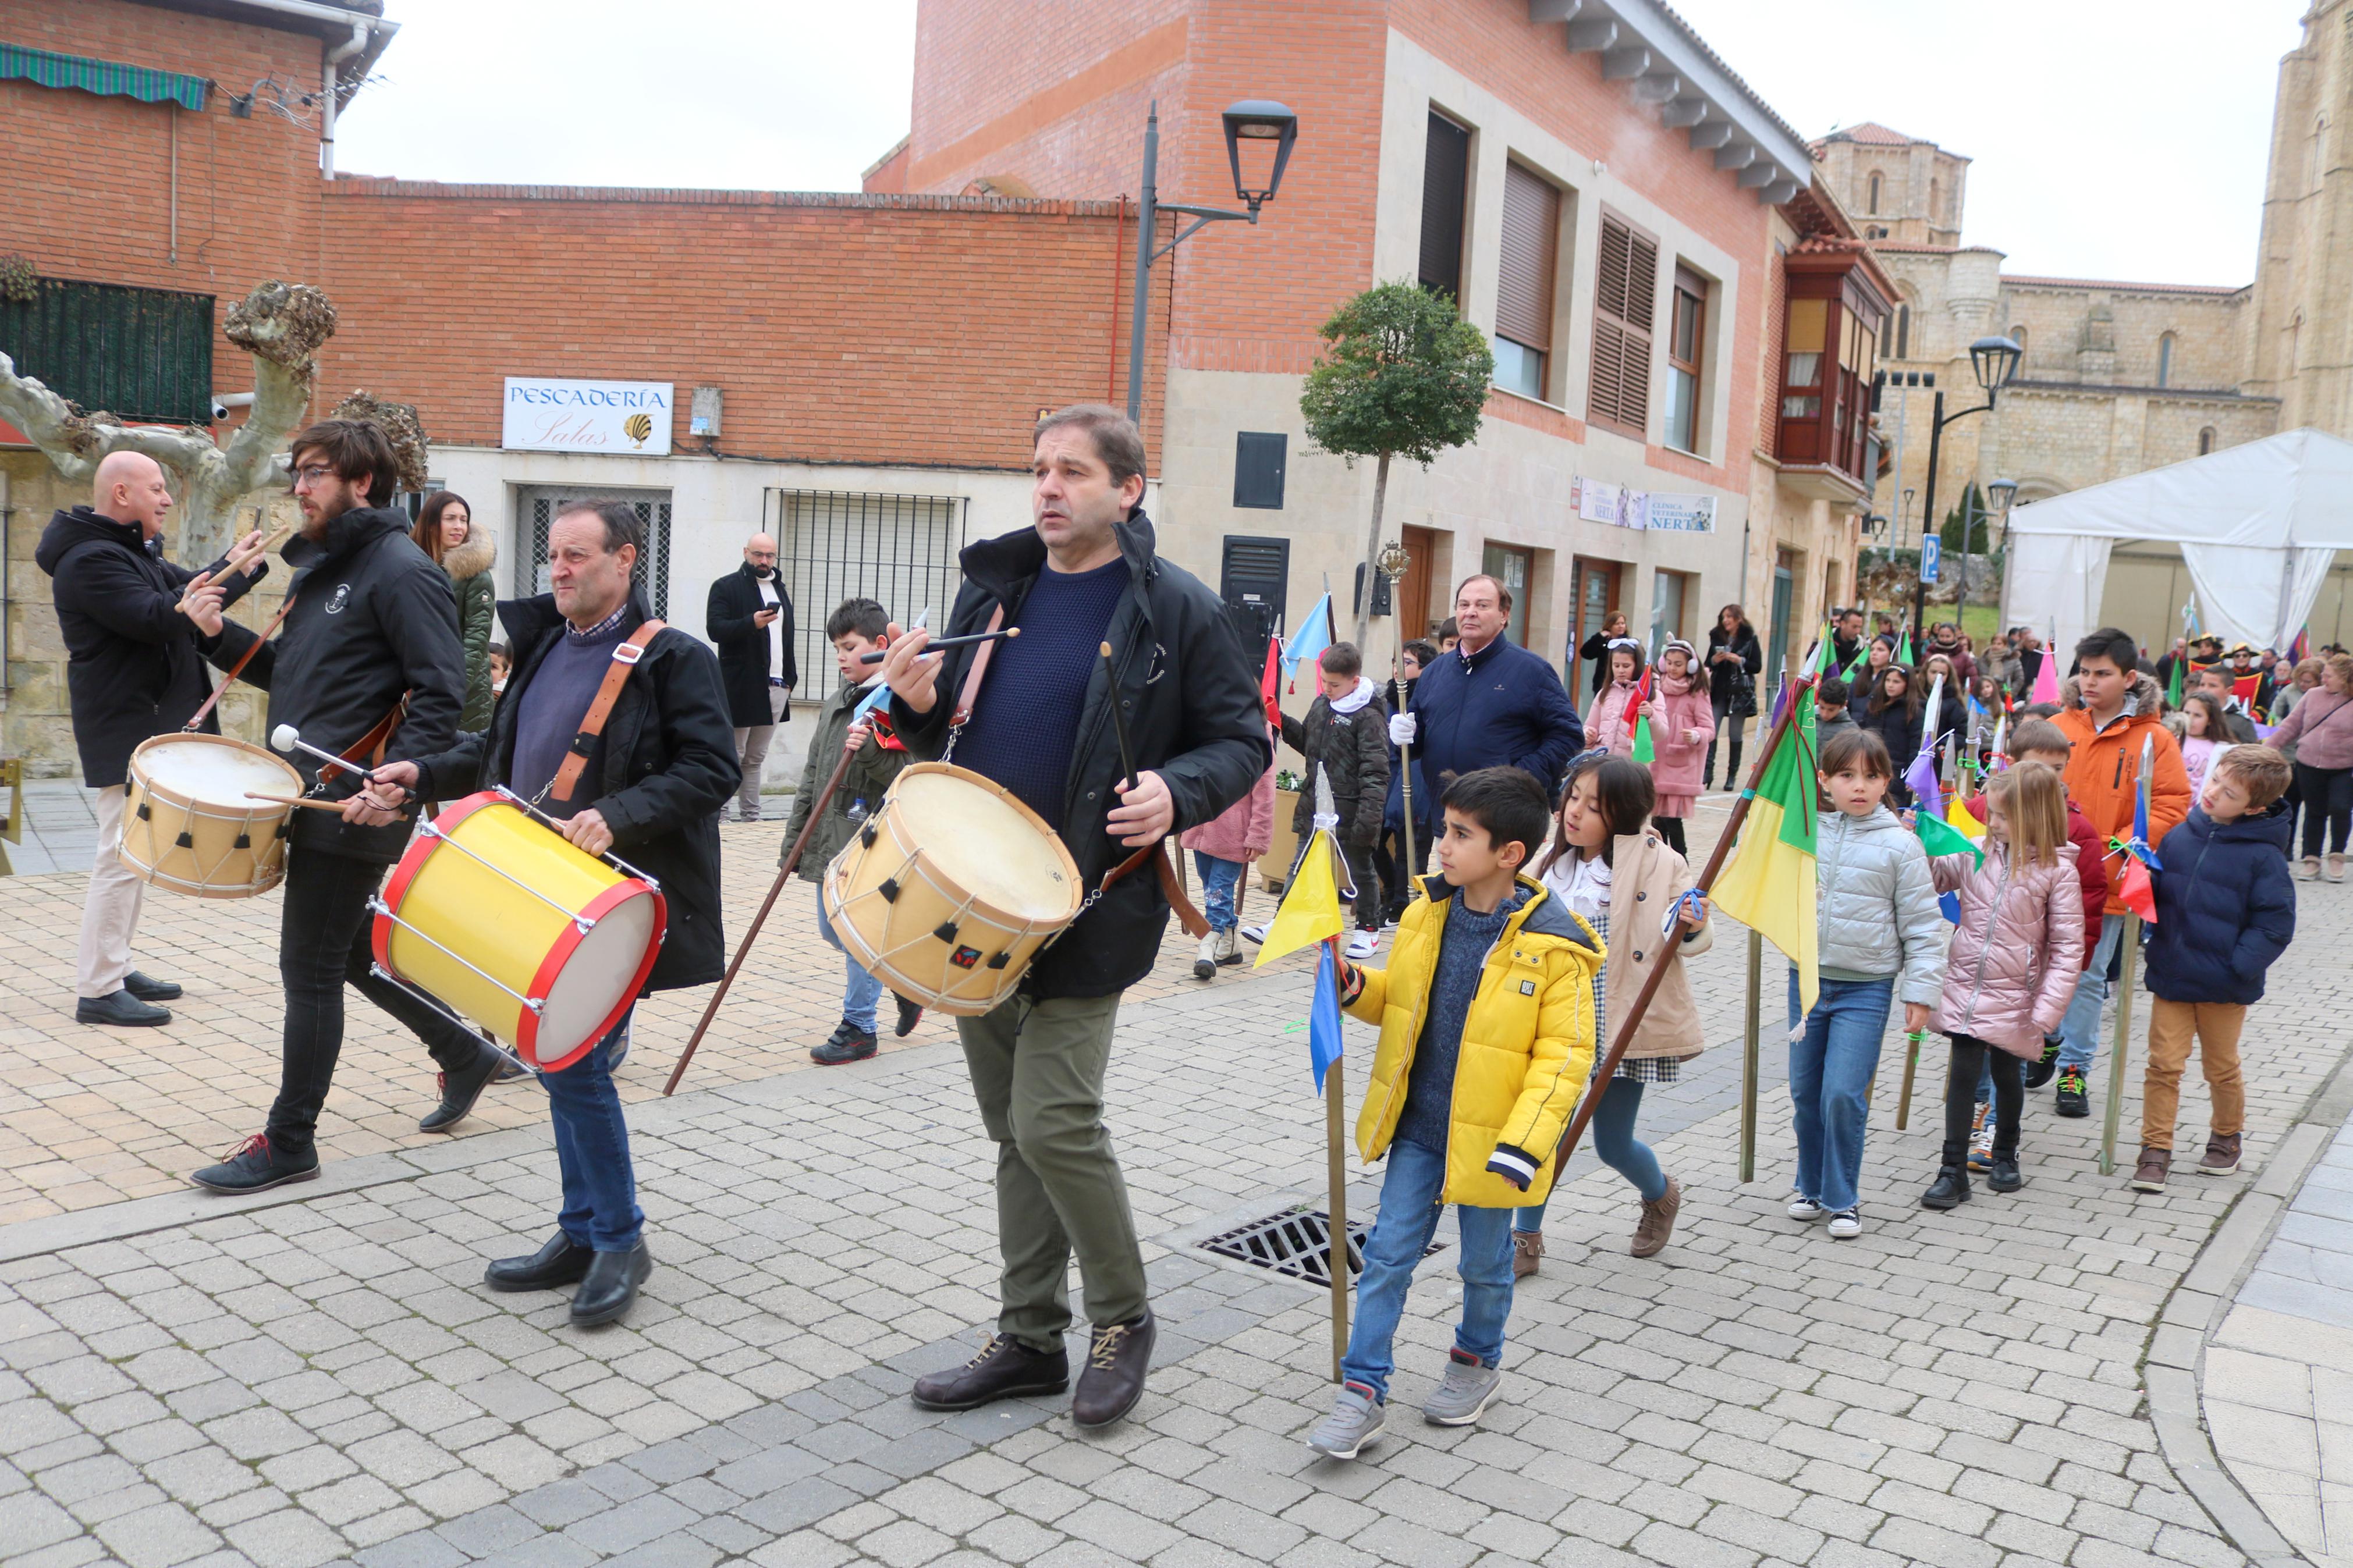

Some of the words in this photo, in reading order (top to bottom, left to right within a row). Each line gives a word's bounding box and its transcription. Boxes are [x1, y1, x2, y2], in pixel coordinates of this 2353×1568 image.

[510, 387, 666, 408] PESCADERÍA
[521, 410, 610, 446] Salas
[1925, 539, 1937, 578] P
[1522, 981, 1534, 990] OUT
